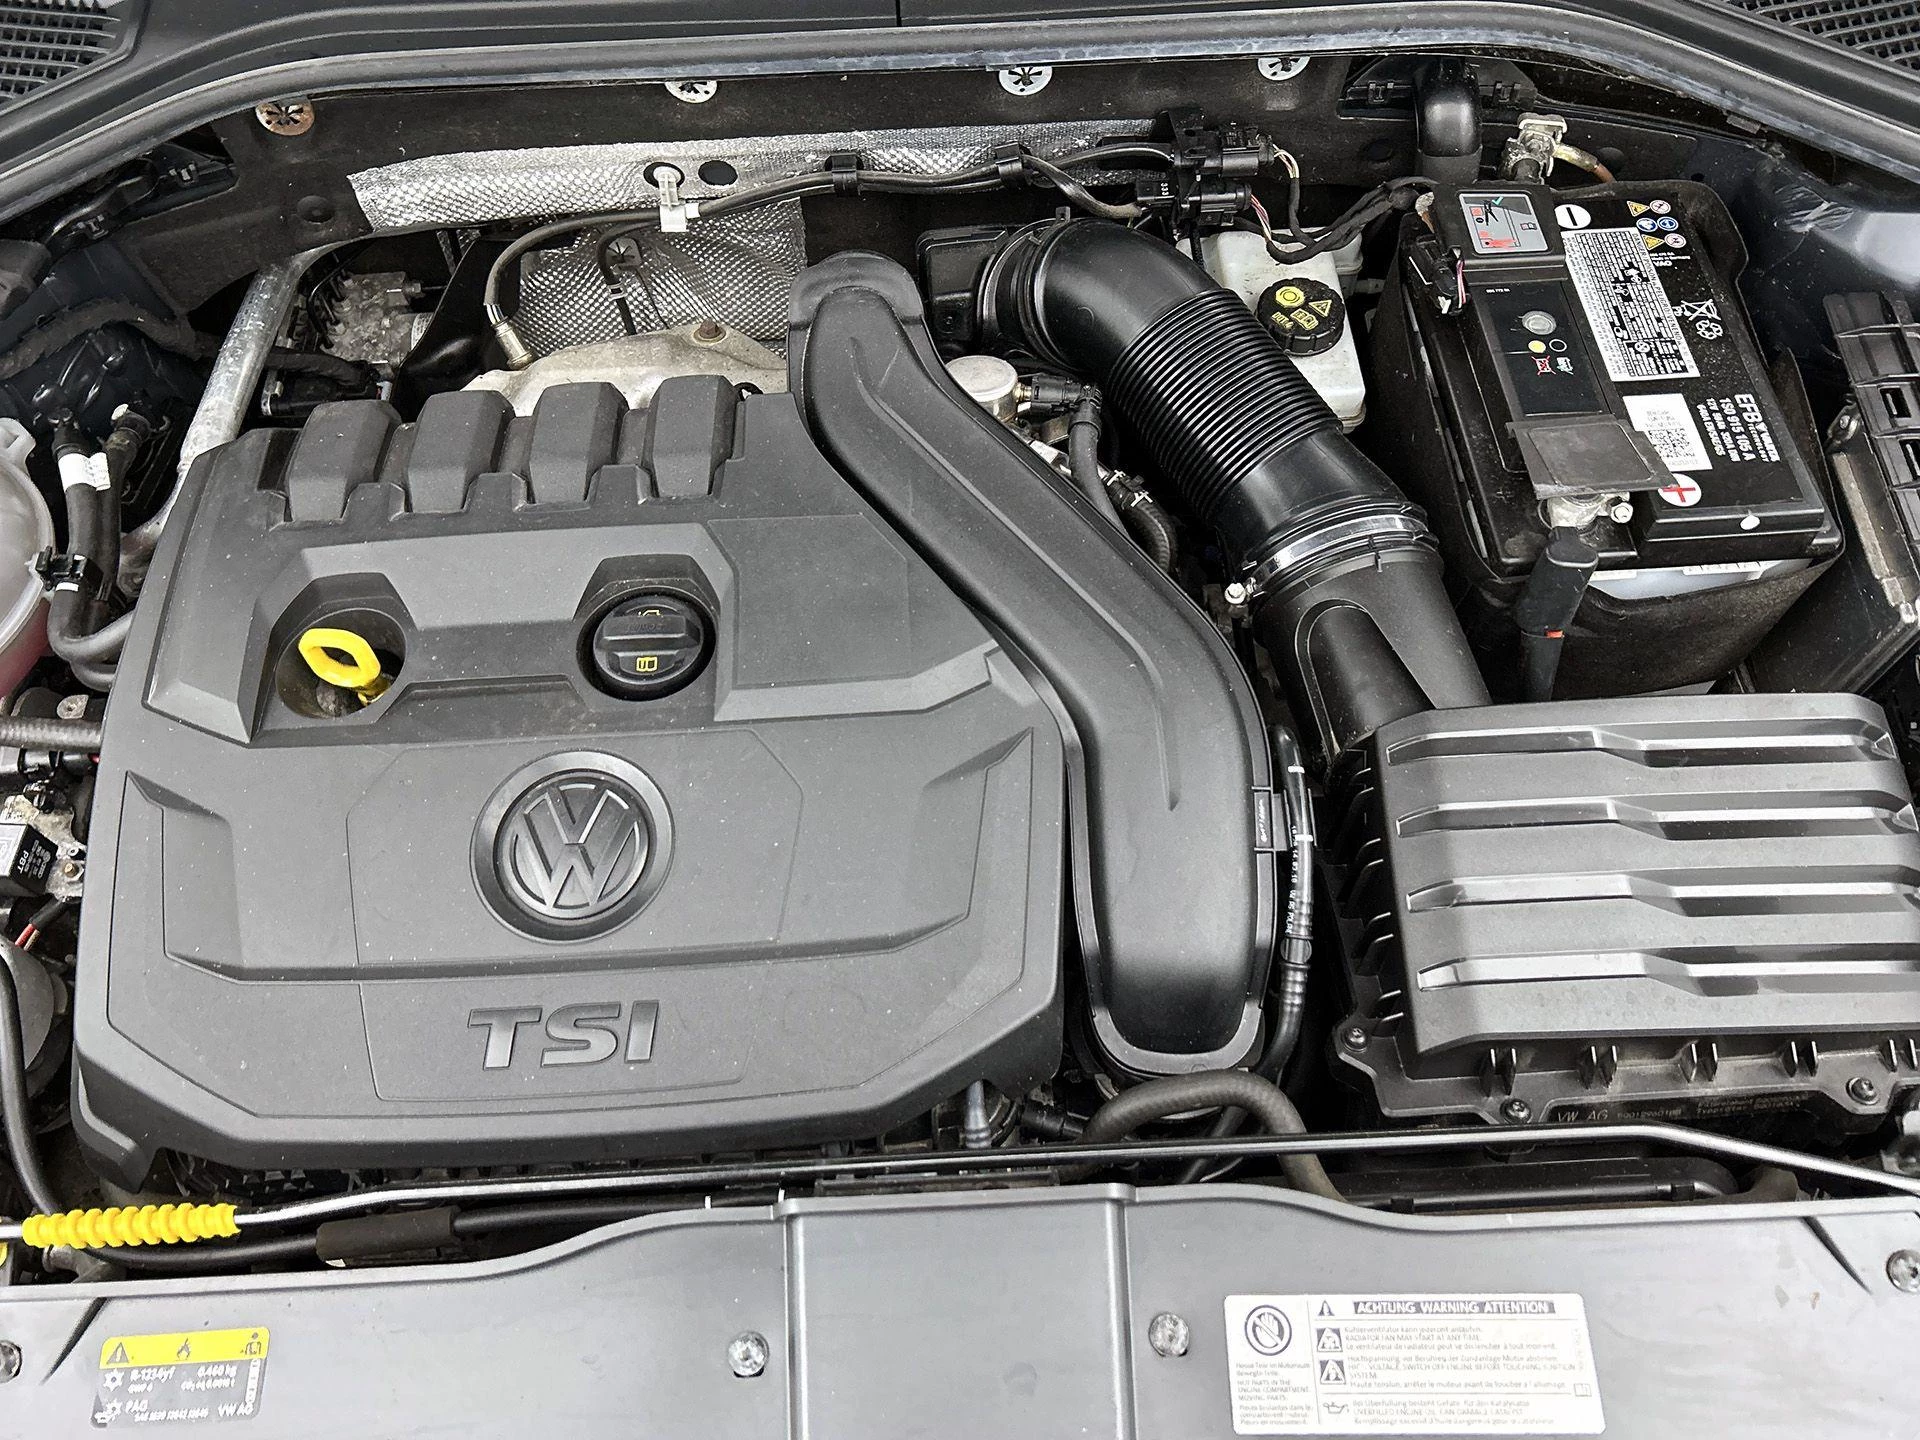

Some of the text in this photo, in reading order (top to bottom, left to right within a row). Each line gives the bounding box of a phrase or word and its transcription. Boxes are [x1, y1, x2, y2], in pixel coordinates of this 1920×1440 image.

[1734, 393, 1763, 422] EFB
[1726, 415, 1745, 433] 915
[1742, 452, 1756, 461] A
[508, 780, 647, 914] VW
[467, 1000, 659, 1071] TSI
[1357, 1301, 1550, 1314] ACHTUNG WARNING ATTENTION
[217, 1401, 237, 1417] VW
